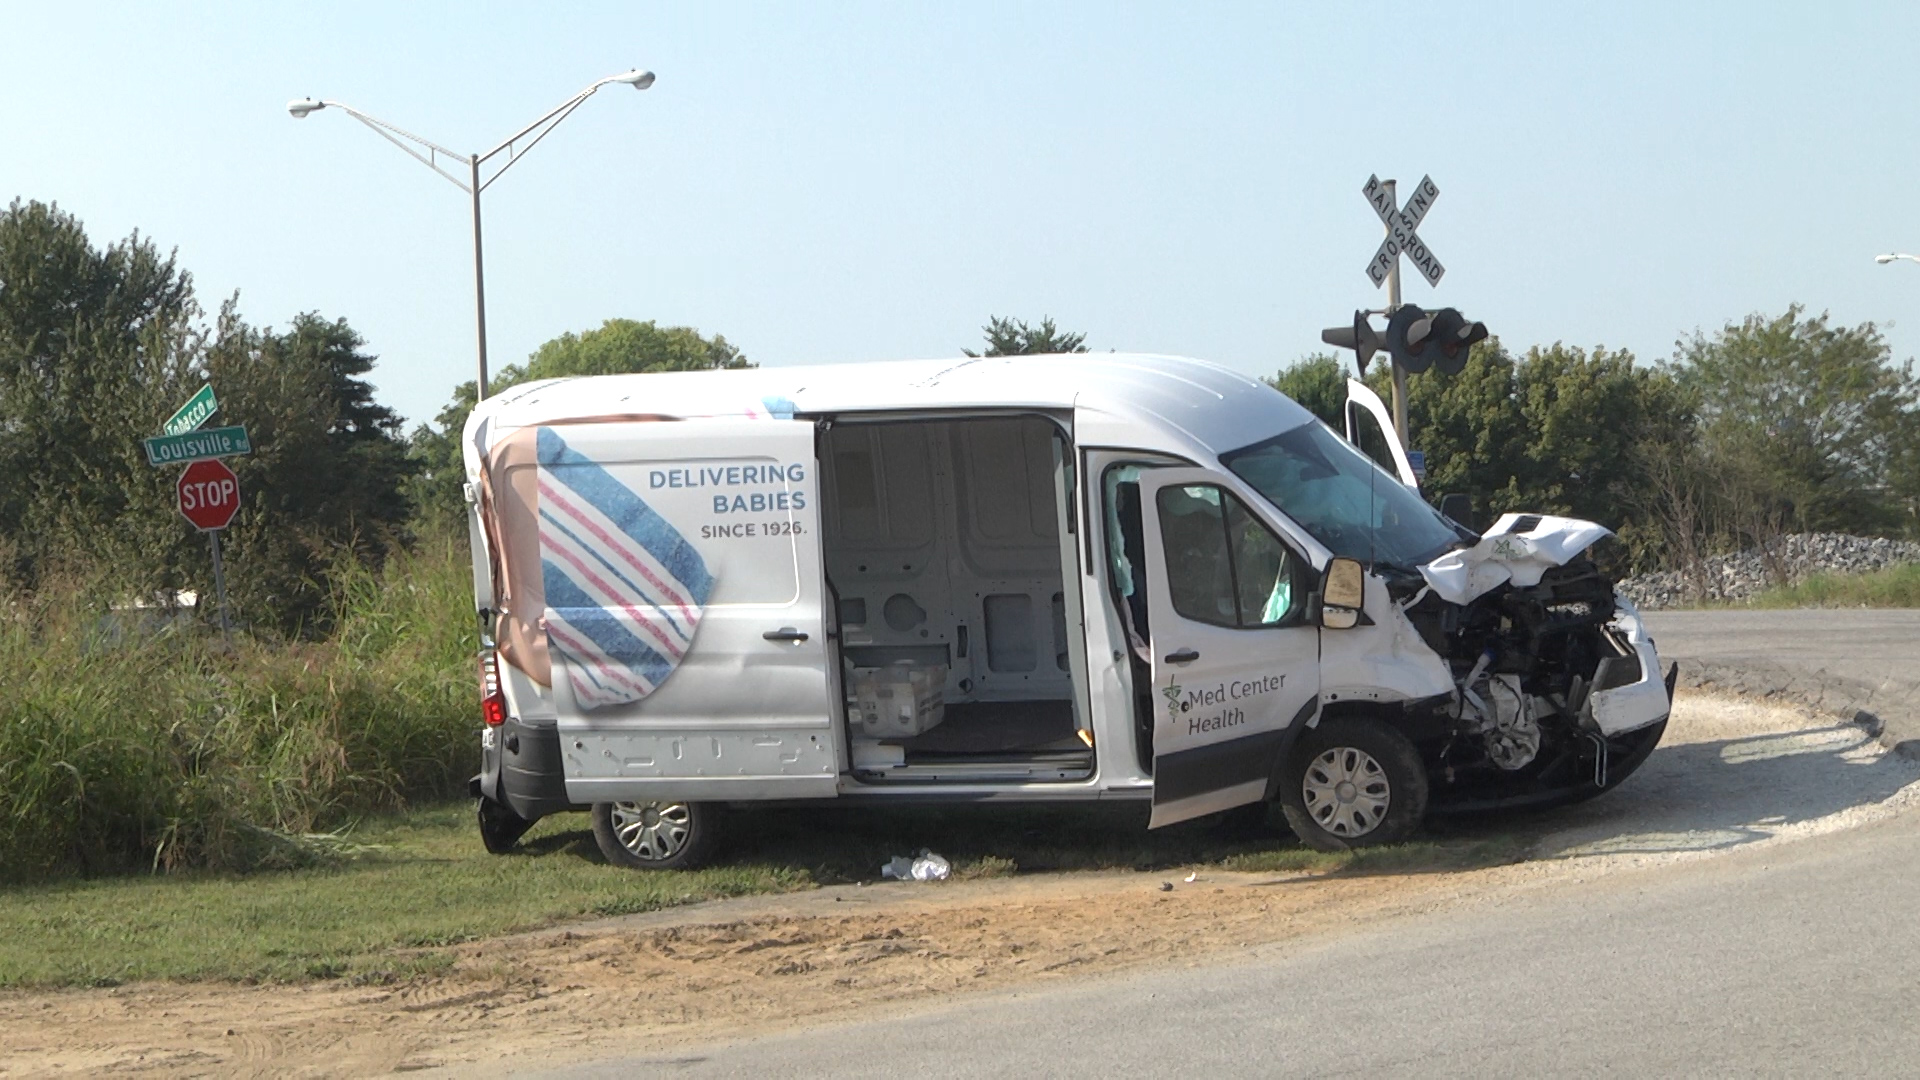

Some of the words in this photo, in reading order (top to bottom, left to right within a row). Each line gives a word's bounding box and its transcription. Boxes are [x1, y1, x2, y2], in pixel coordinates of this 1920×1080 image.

[1371, 181, 1435, 282] CROSSING
[166, 401, 206, 436] Tobacco
[149, 434, 232, 462] Louisville
[236, 439, 249, 450] Rd
[649, 463, 805, 489] DELIVERING
[183, 479, 234, 510] STOP
[713, 491, 806, 514] BABIES
[701, 523, 756, 539] SINCE
[1188, 683, 1226, 709] Med
[1230, 674, 1287, 700] Center
[1188, 707, 1245, 735] Health
